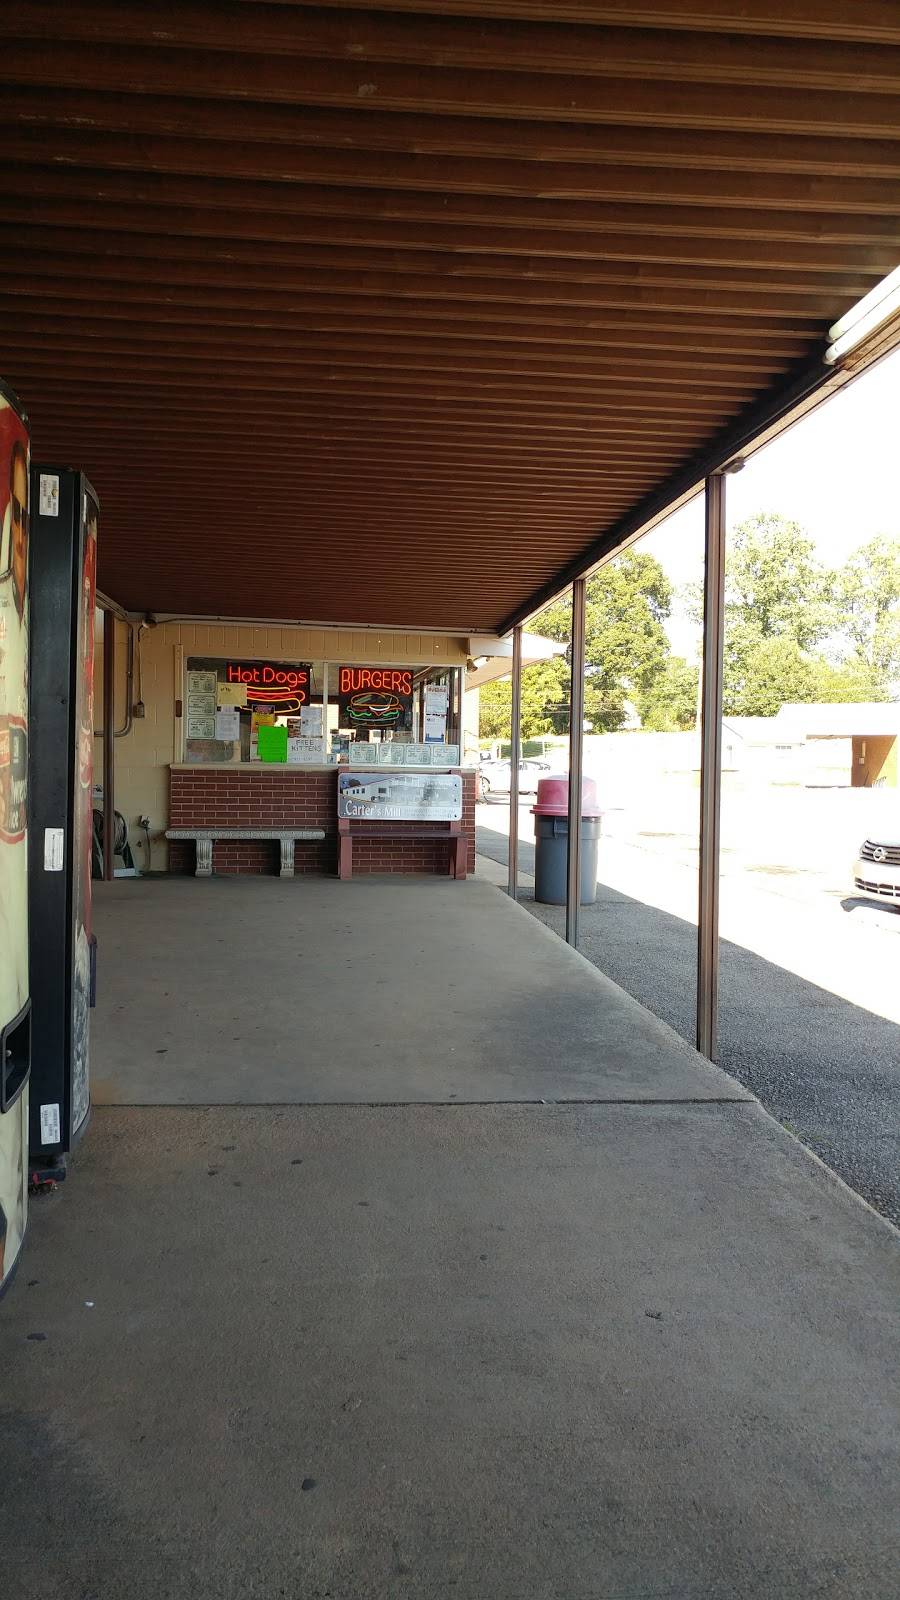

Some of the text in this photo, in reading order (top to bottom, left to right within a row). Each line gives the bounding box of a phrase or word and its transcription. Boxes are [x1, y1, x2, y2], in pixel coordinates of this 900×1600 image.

[228, 666, 260, 683] Hot
[263, 667, 308, 688] Dogs
[341, 668, 412, 696] BURGERS
[291, 745, 322, 753] KITTENS
[345, 800, 401, 817] Carter's Mill
